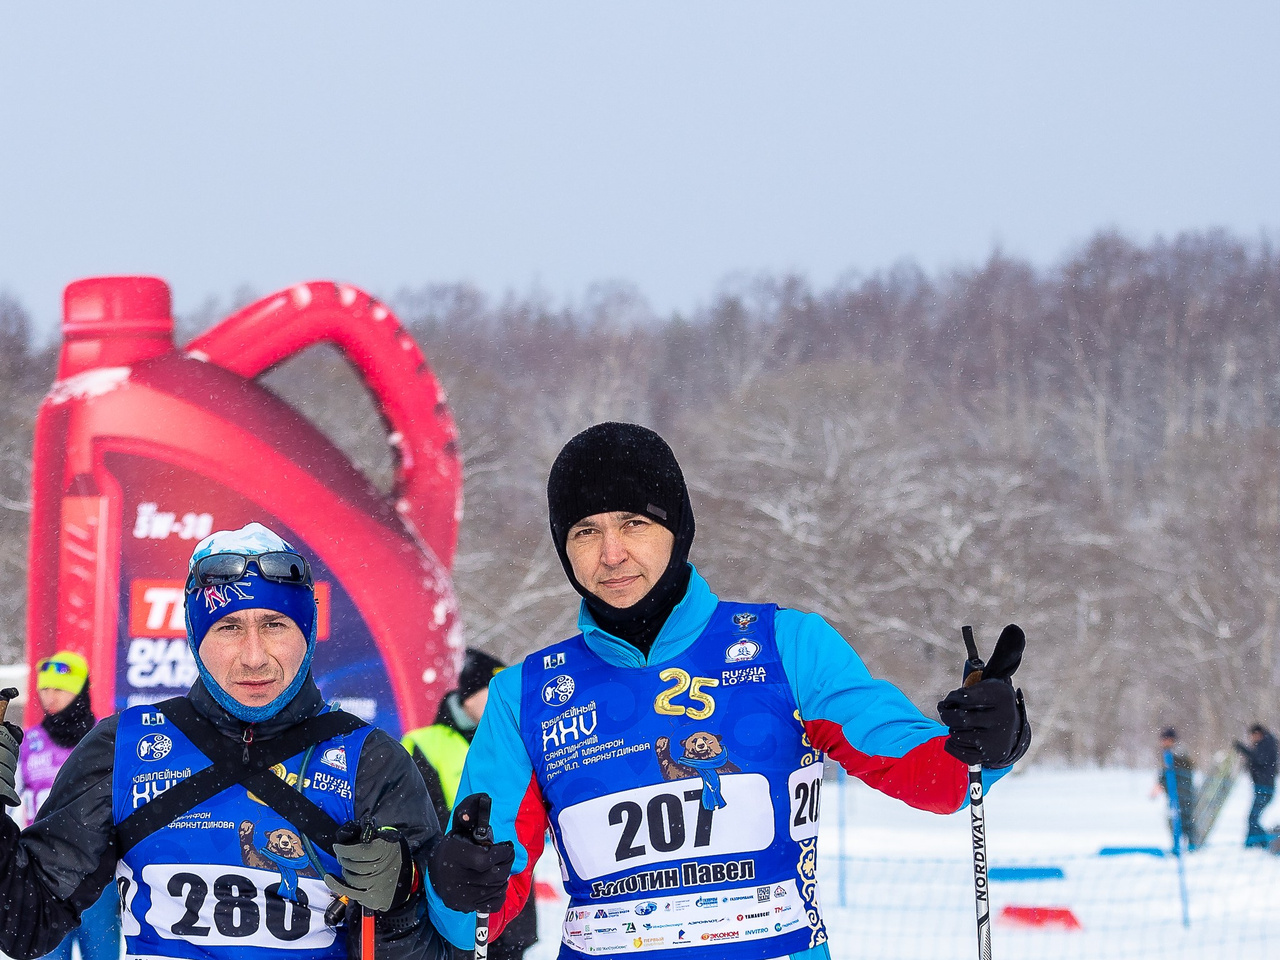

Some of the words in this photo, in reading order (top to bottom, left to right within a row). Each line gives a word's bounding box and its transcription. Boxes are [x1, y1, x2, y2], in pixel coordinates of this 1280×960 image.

[721, 666, 767, 679] RUSSIA
[721, 673, 767, 686] LOPPET
[653, 667, 719, 721] 25
[541, 700, 597, 730] ЮБИЛЕЙНЫЙ
[542, 711, 598, 752] XXV
[581, 738, 625, 757] МАРАФОН
[582, 742, 652, 766] ФАРХУТДИНОВА
[132, 767, 192, 784] ЮБИЛЕЙНЫЙ
[132, 779, 177, 809] XX
[167, 820, 235, 830] ФАРХУТДИНОВА
[607, 788, 715, 862] 207
[793, 777, 822, 827] 20
[972, 812, 987, 902] NORDWAY
[681, 858, 756, 887] Павел
[166, 871, 312, 942] 280
[710, 931, 740, 939] ЭКОНОМ
[745, 928, 769, 936] INVITRO
